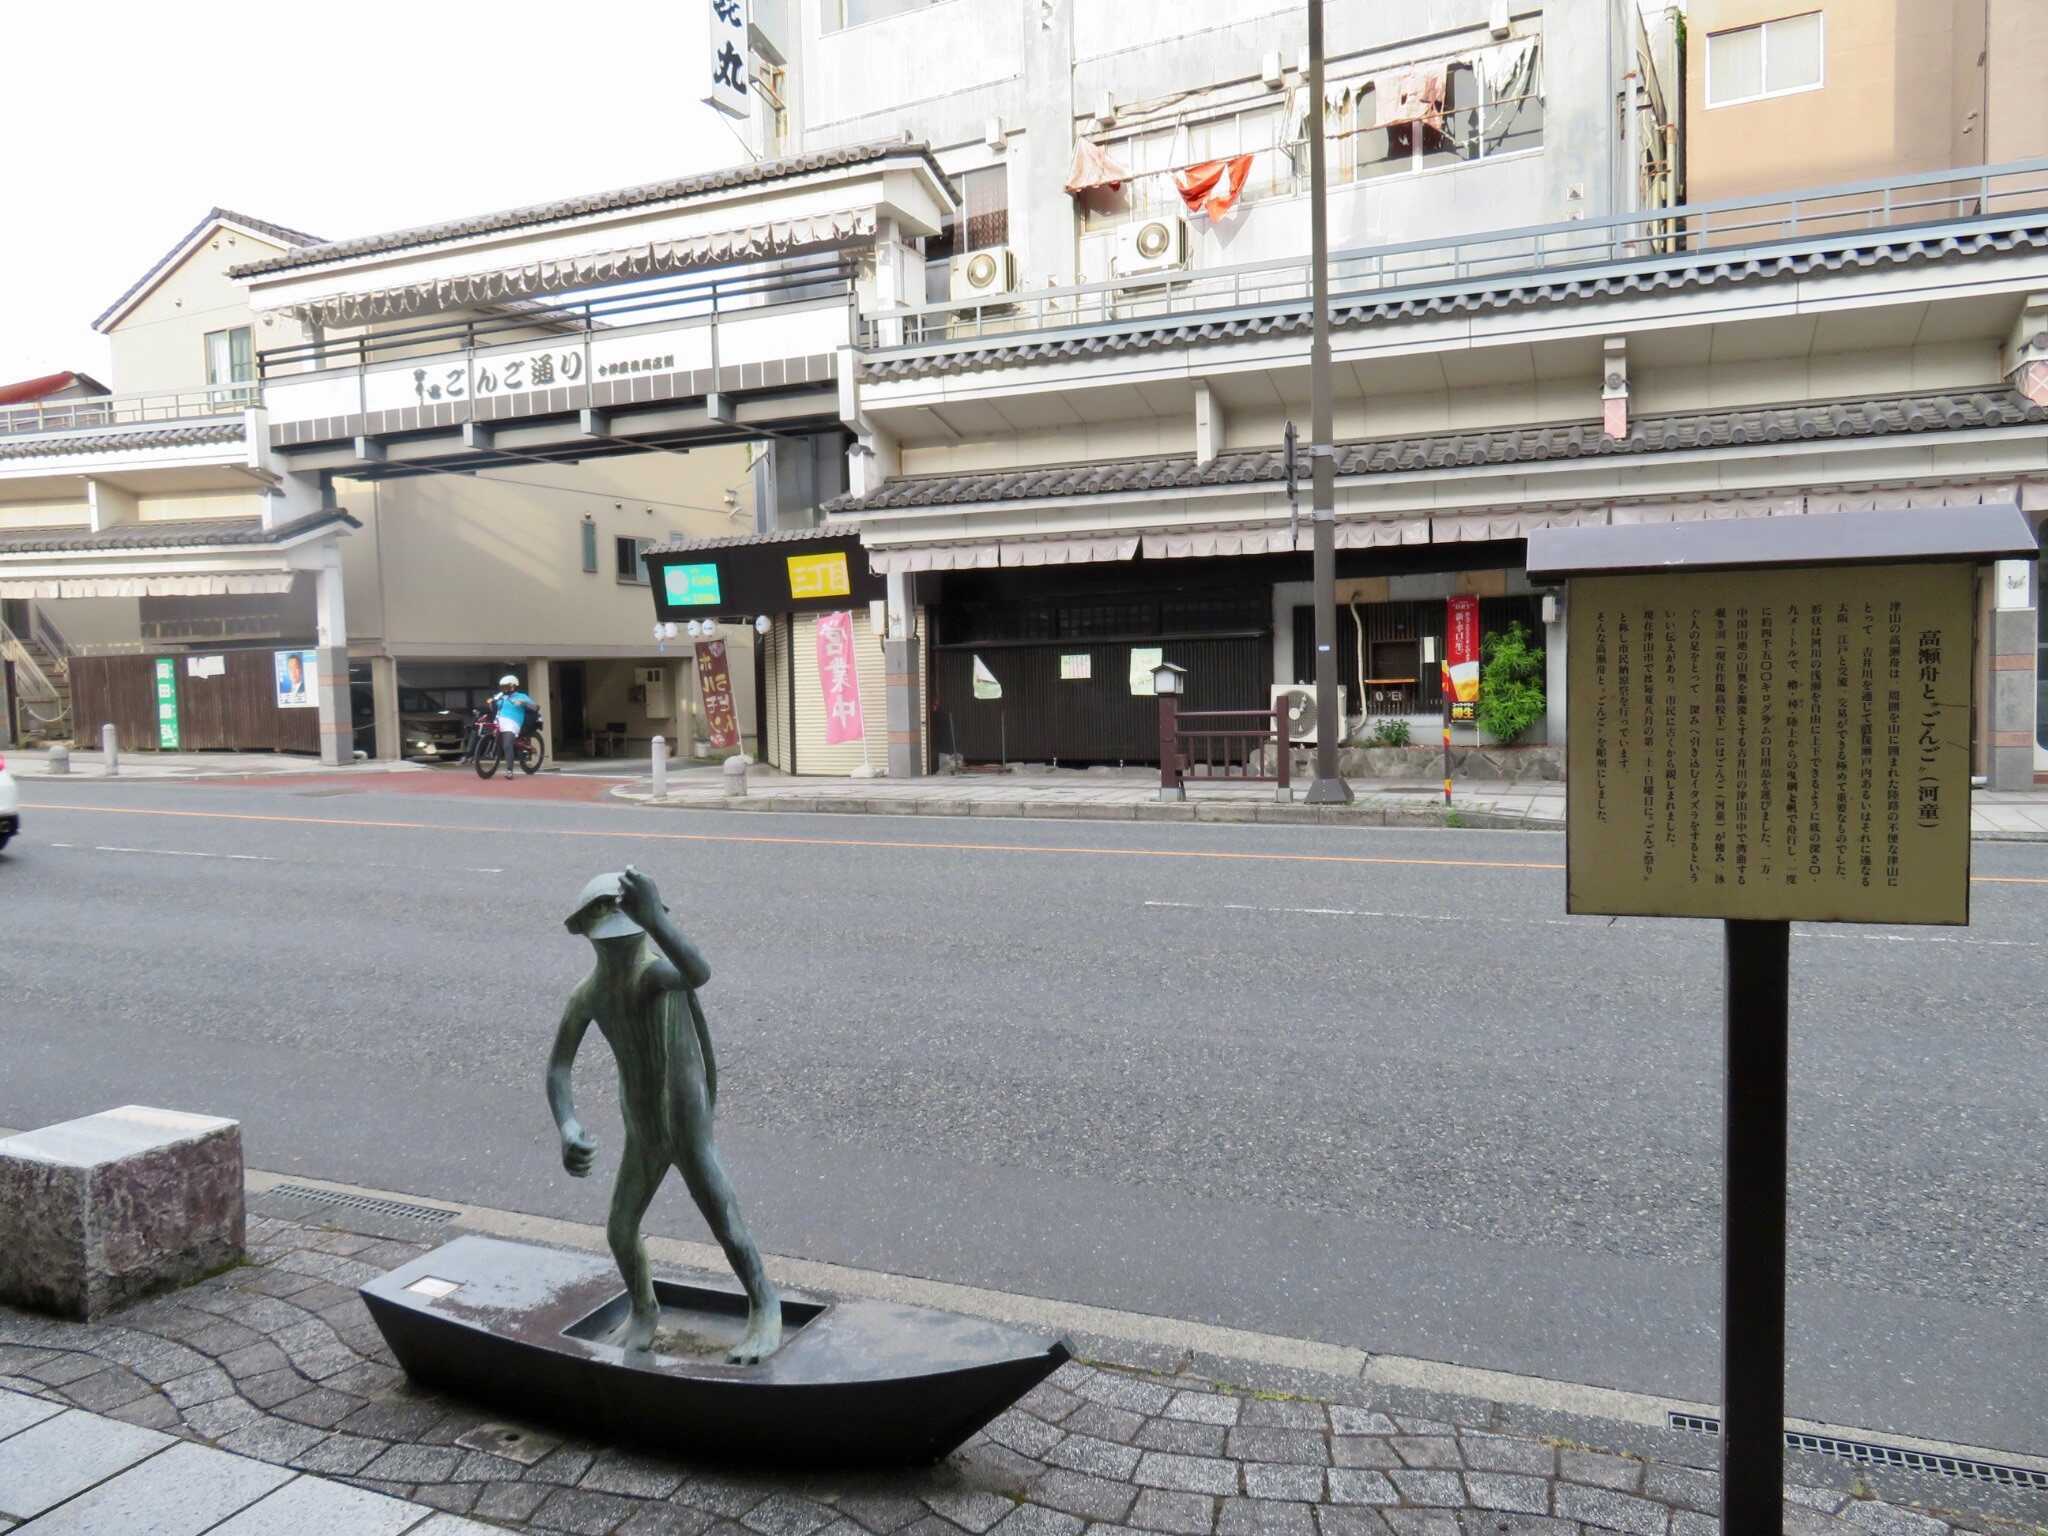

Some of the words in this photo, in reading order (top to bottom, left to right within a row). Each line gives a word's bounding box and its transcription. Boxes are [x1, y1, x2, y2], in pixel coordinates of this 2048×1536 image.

[446, 351, 582, 397] ごんご通り
[819, 620, 855, 728] 営業中
